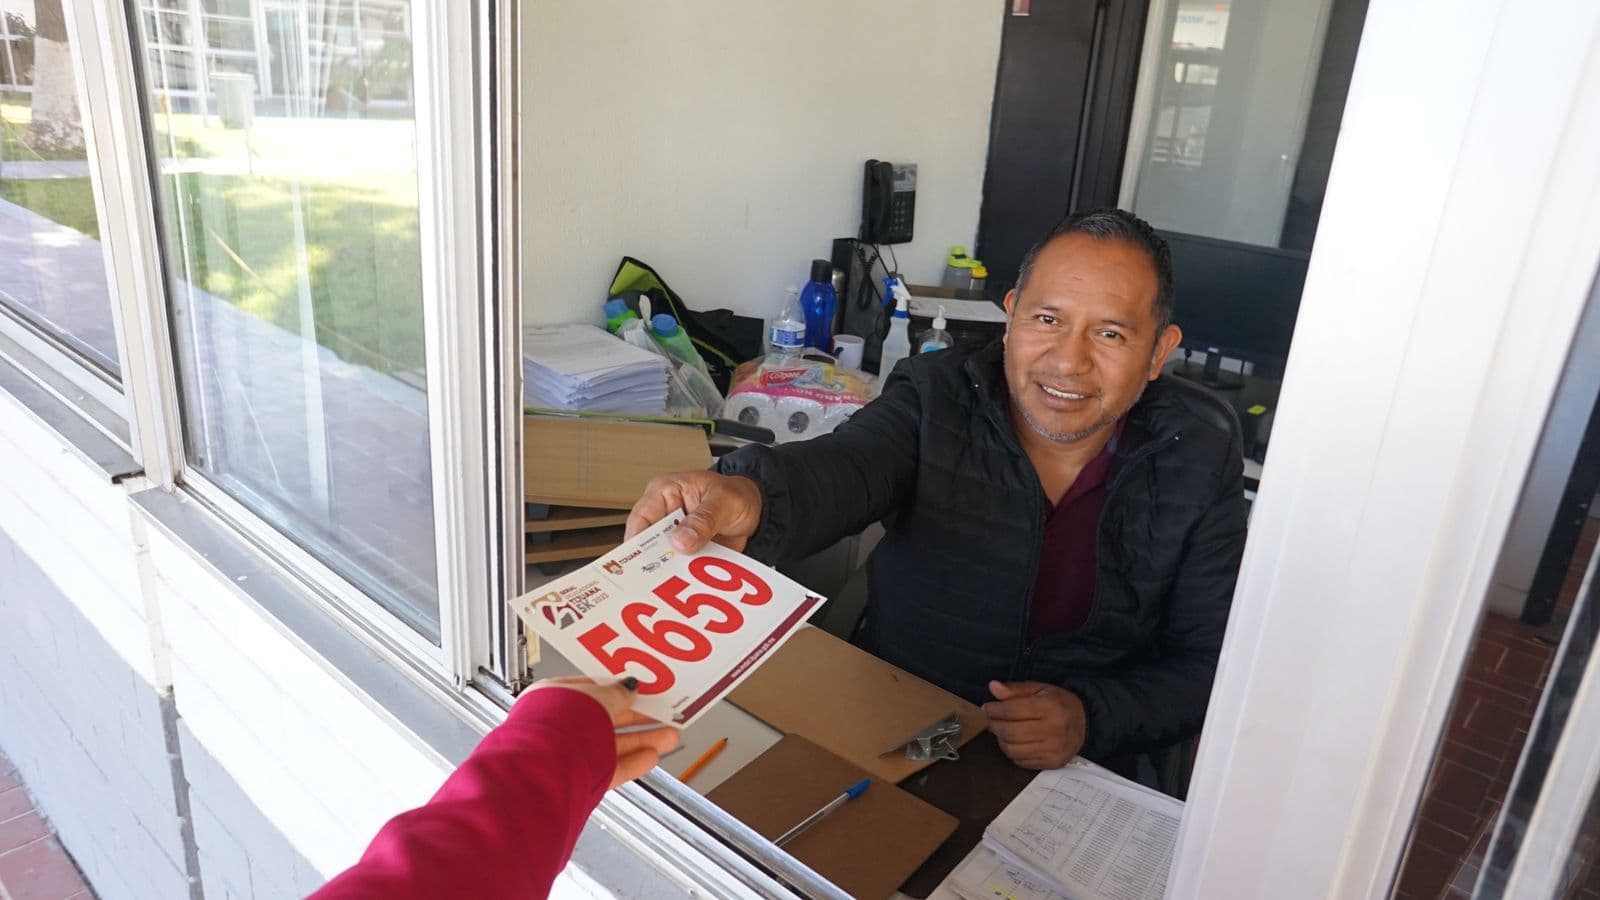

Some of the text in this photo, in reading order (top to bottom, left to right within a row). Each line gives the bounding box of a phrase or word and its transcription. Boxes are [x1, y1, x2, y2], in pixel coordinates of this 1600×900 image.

[768, 371, 800, 381] Colgate
[569, 586, 602, 605] TIJUANA
[576, 599, 597, 613] 5K
[576, 556, 773, 695] 5659
